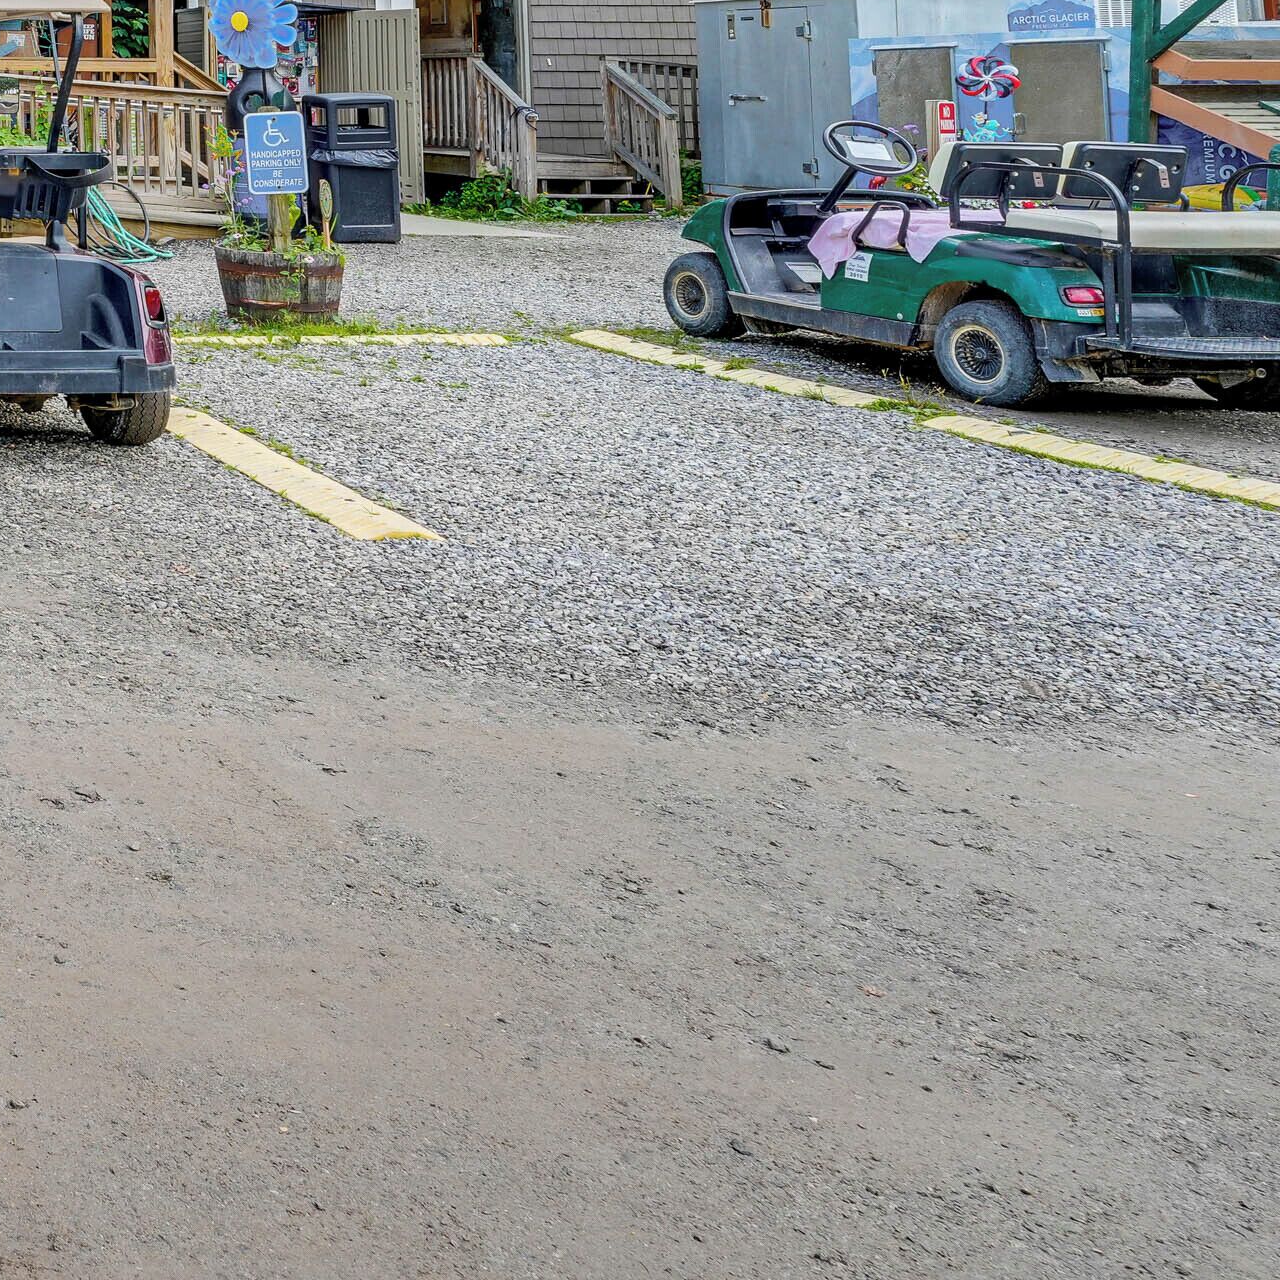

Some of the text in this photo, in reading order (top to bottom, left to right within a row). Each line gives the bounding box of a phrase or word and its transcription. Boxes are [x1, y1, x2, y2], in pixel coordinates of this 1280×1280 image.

[1012, 12, 1090, 25] ARCTIC GLACIER
[251, 149, 301, 159] HANDICAPPED
[251, 157, 302, 168] PARKING ONLY
[272, 169, 283, 178] BE
[253, 178, 303, 188] CONSIDERATE
